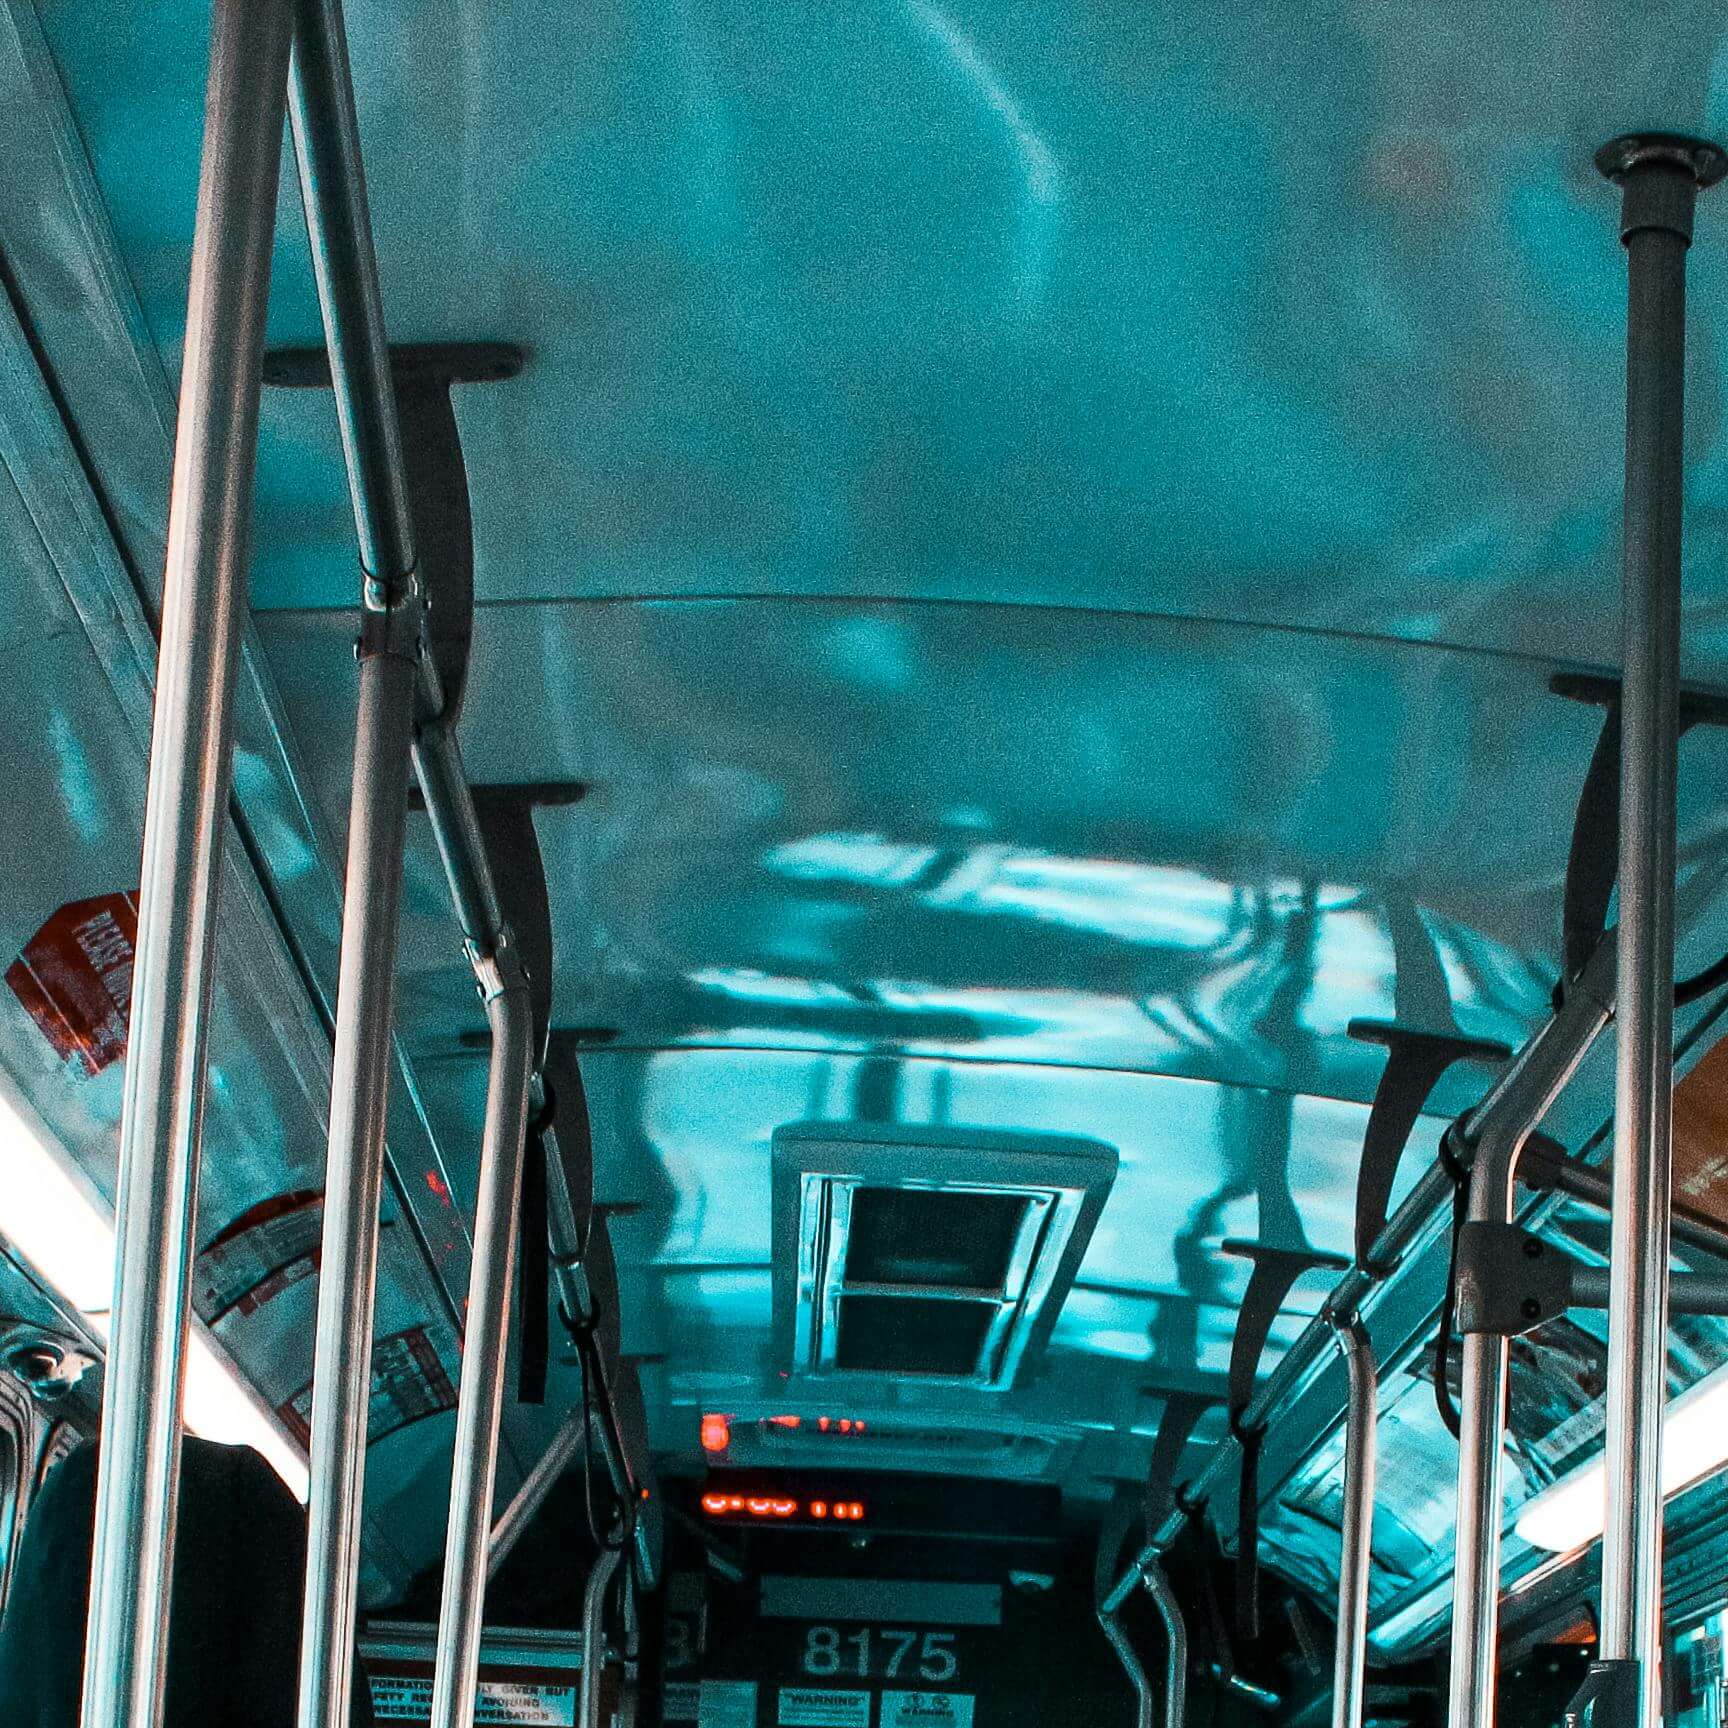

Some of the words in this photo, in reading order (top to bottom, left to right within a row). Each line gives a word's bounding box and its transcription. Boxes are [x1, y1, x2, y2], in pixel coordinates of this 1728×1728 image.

[803, 1626, 958, 1682] 8175
[371, 1678, 434, 1690] FORMATIO
[373, 1704, 432, 1716] NECESSA
